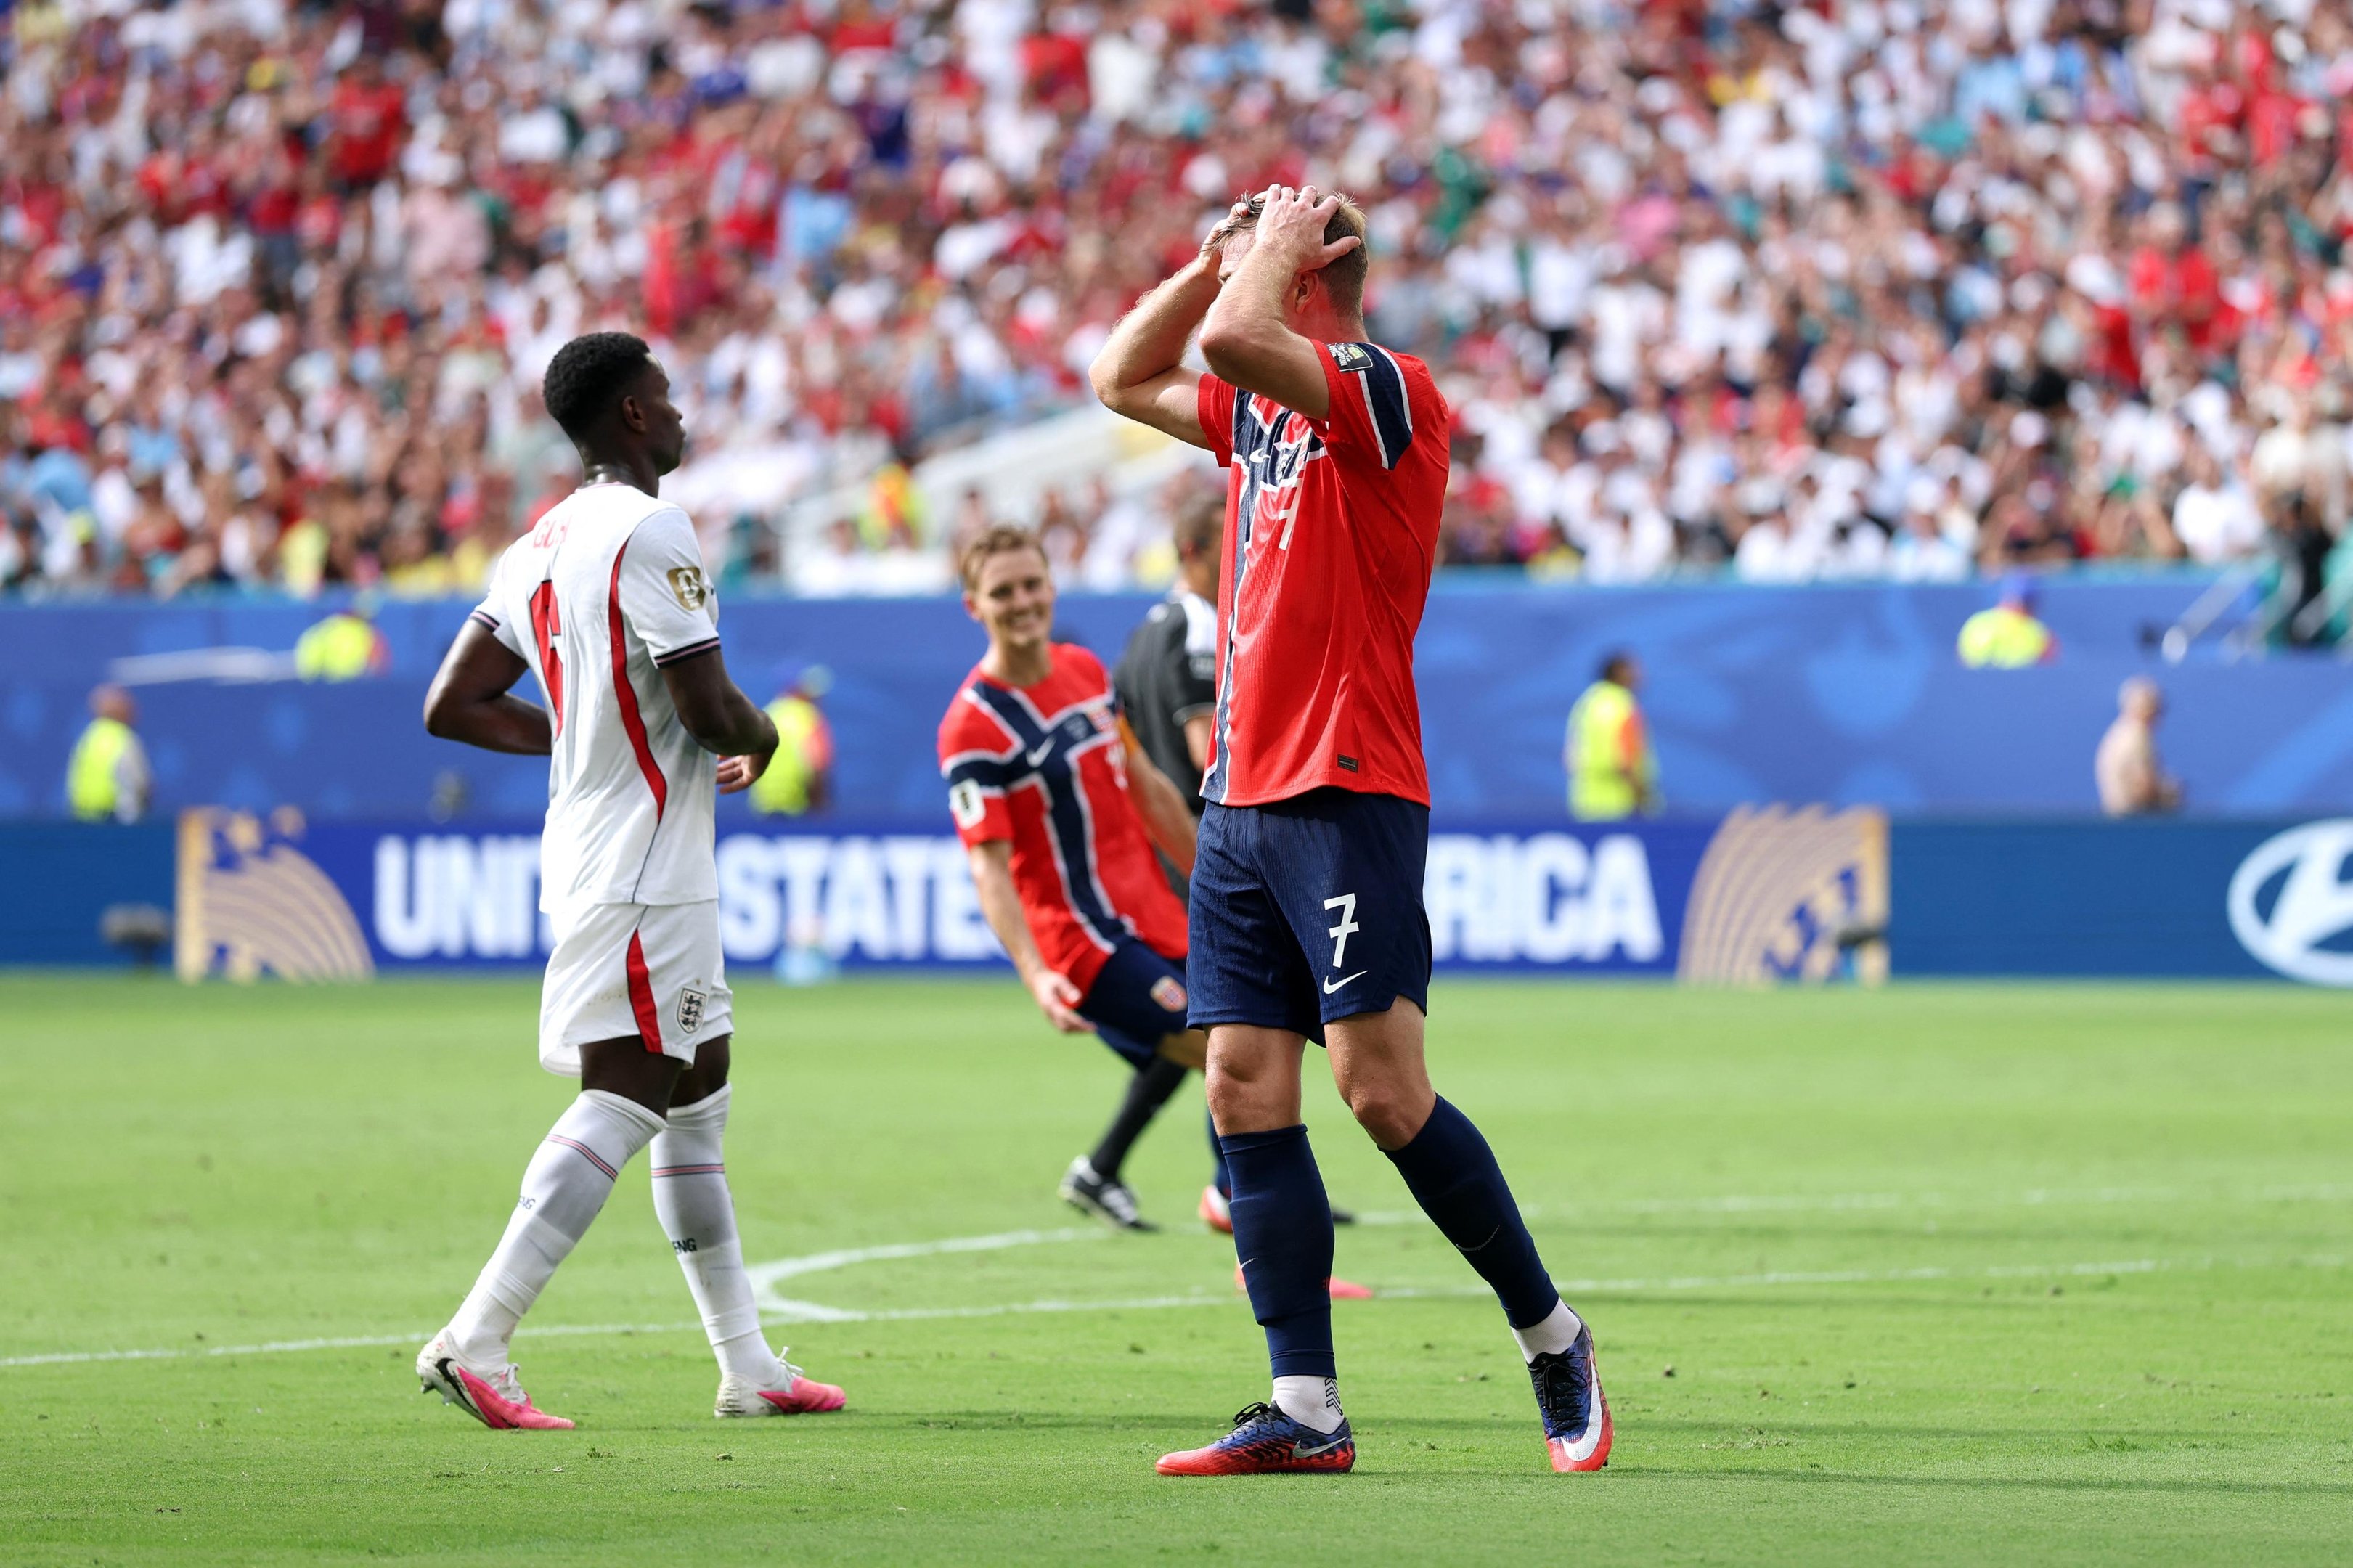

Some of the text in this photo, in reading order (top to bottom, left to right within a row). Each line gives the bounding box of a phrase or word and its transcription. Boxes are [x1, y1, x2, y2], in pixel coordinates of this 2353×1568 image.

[373, 832, 1665, 963] UNI STATE RICA
[1324, 893, 1359, 968] 7
